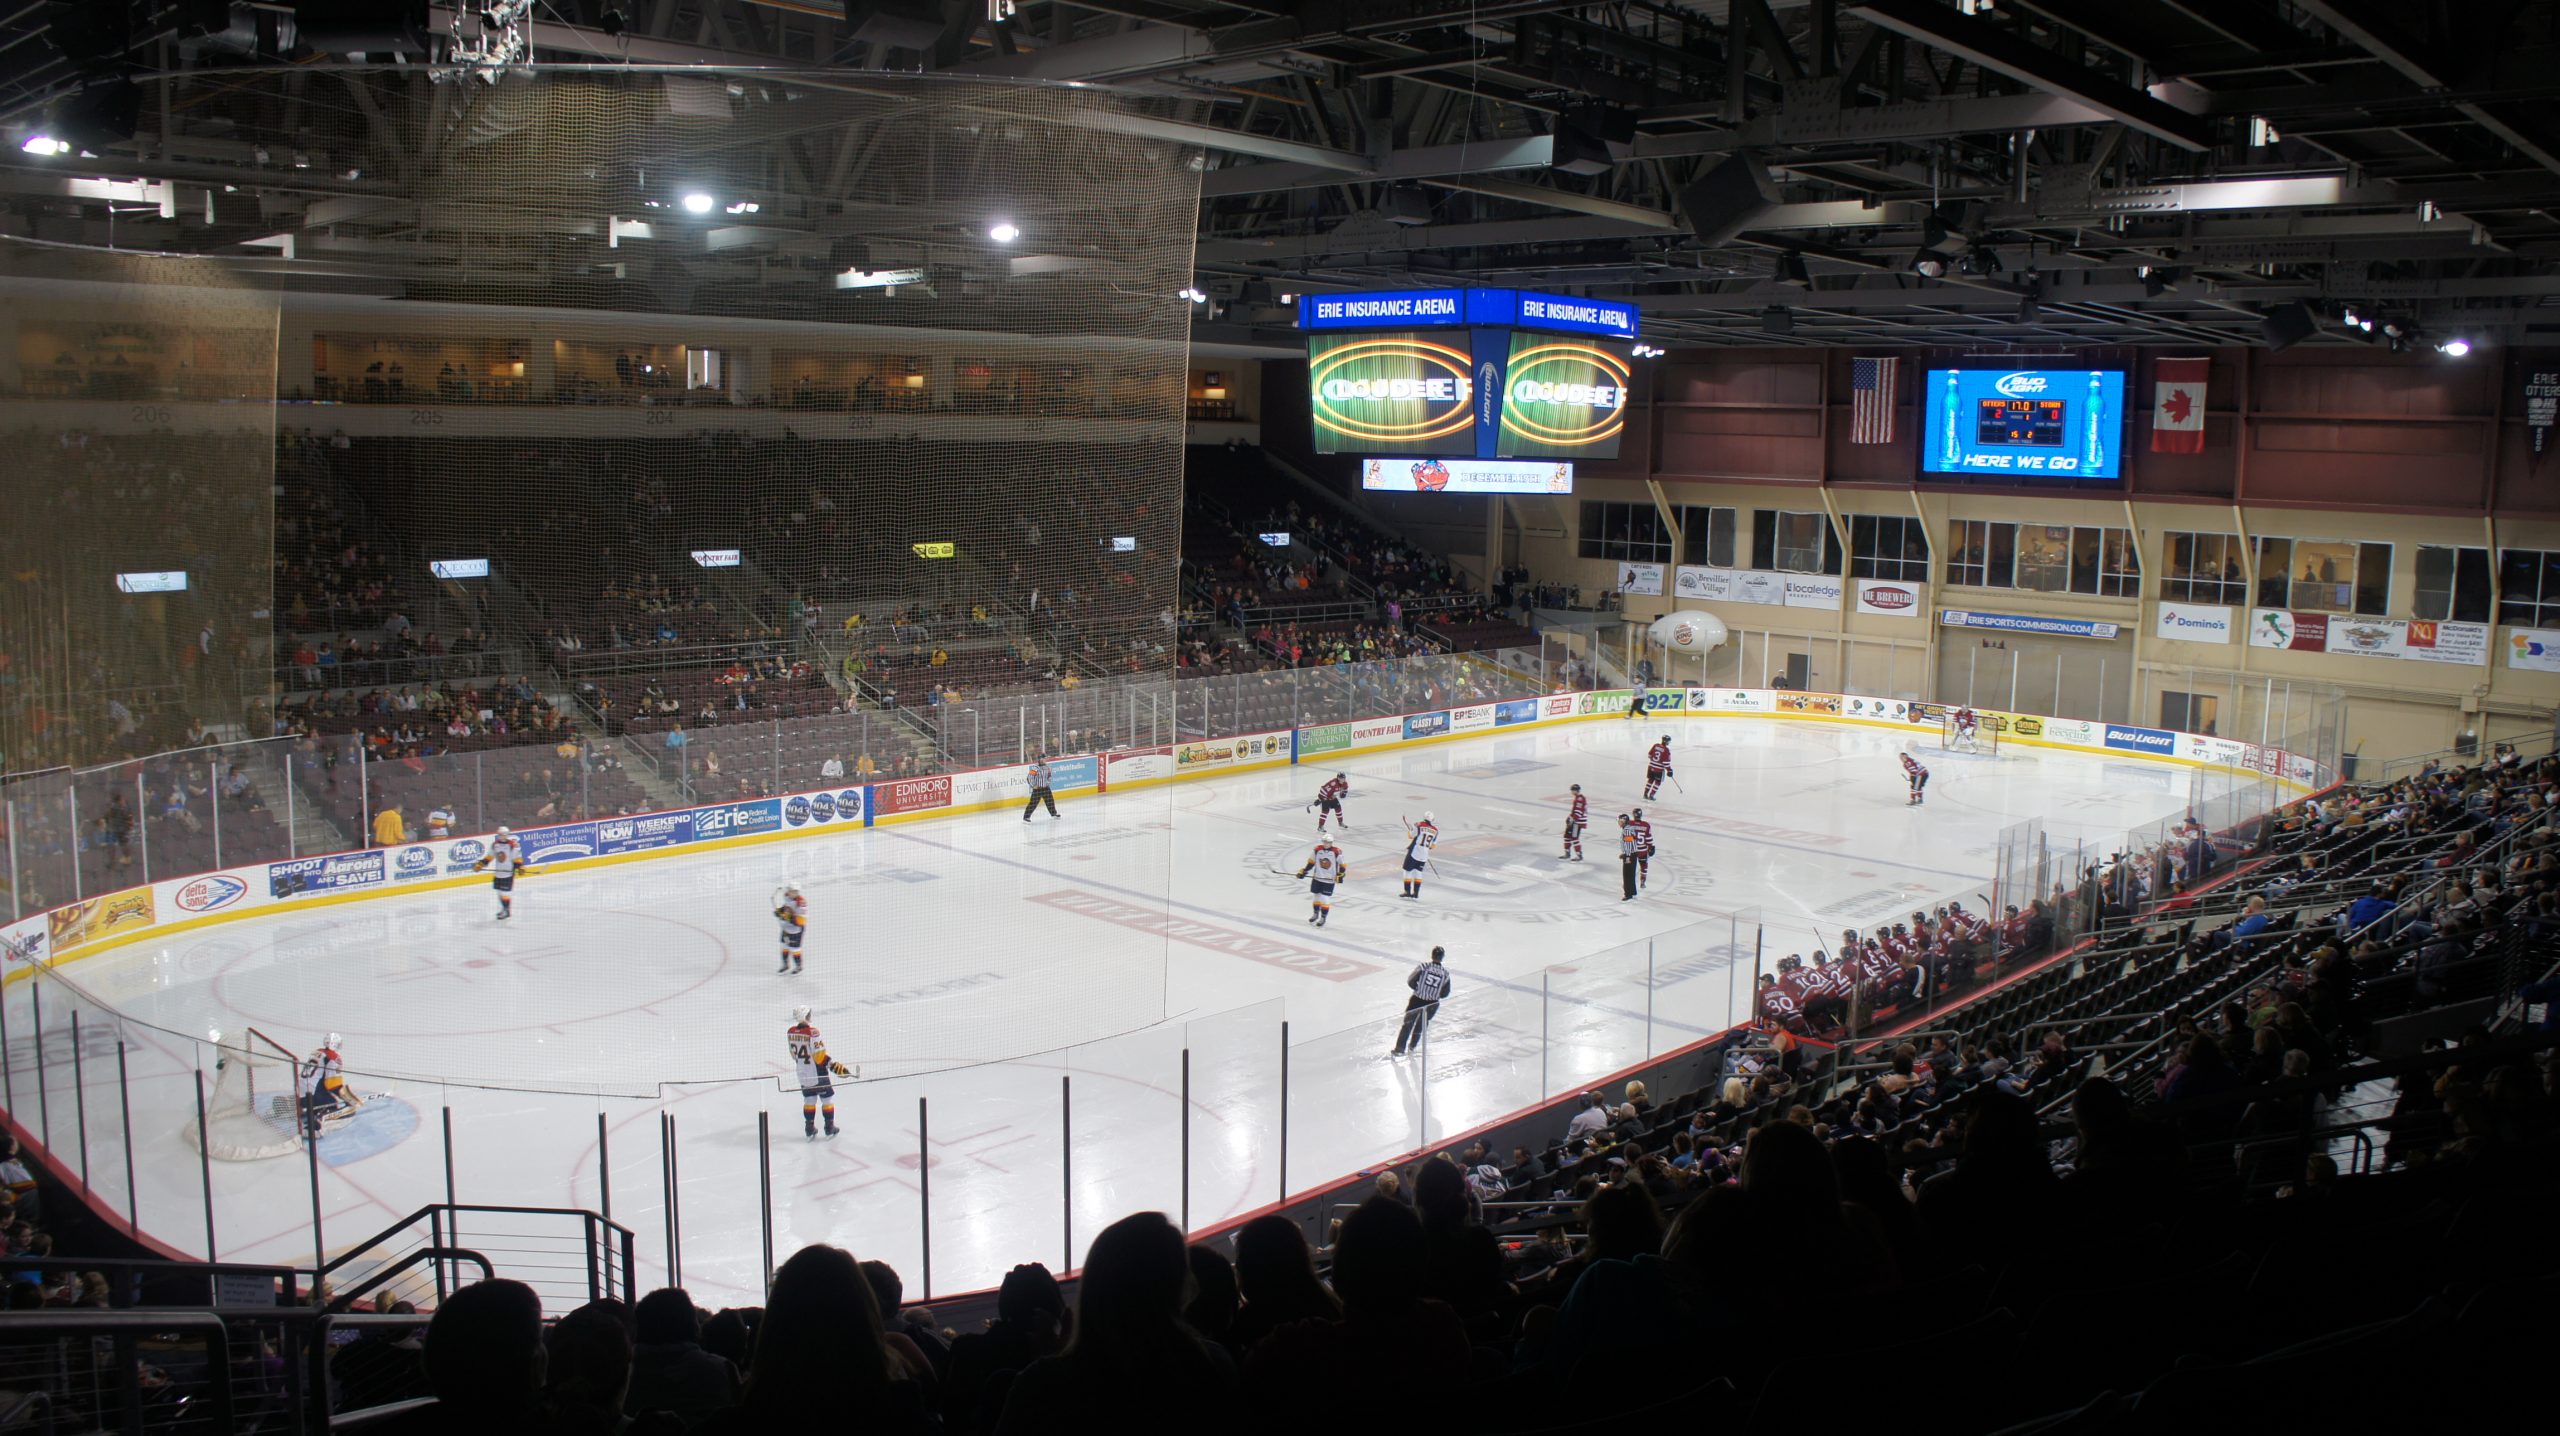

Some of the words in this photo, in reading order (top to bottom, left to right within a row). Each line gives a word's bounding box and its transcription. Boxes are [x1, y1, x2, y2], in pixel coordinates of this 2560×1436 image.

[1318, 303, 1342, 318] ERIE
[1345, 300, 1411, 317] INSURANCE
[1414, 298, 1456, 315] ARENA
[1523, 300, 1545, 317] ERIE
[1546, 303, 1597, 322] INSURANCE
[1598, 309, 1628, 328] ARENA
[2010, 376, 2046, 385] BUD
[2533, 373, 2558, 384] ERIE
[2003, 384, 2048, 392] LIGHT
[2012, 401, 2030, 411] 17.0
[132, 406, 170, 423] 206
[412, 410, 443, 424] 205
[646, 411, 673, 424] 204
[1995, 409, 2002, 418] 2
[2051, 410, 2058, 419] 0
[2027, 431, 2033, 439] 2
[1963, 454, 2013, 468] HERE
[2017, 456, 2046, 469] WE
[2048, 456, 2078, 470] GO
[1698, 573, 1729, 583] Brevillier
[1702, 583, 1727, 594] Village
[1793, 583, 1841, 597] localedge
[1968, 615, 1984, 625] ERIE
[1985, 617, 2015, 628] SPORTS
[2015, 620, 2091, 634] COMMISSION.COM
[2177, 617, 2226, 630] Domino's
[2442, 625, 2482, 633] McDonald's
[1676, 631, 1692, 640] KING
[1647, 694, 1684, 710] 92.7
[1310, 724, 1350, 737] MERCYHURST
[1411, 718, 1431, 729] CLASSY
[1310, 733, 1349, 745] UNIVERSITY
[1353, 727, 1386, 740] COUNTRY
[1386, 724, 1402, 735] FAIR
[2107, 730, 2134, 741] BUD
[2135, 734, 2174, 747] LIGHT
[1652, 751, 1661, 762] 3
[896, 778, 949, 797] EDINBORO
[956, 784, 982, 794] UPMC
[983, 780, 1010, 791] HEALTH
[1010, 777, 1028, 788] PLAN
[896, 790, 948, 805] UNIVERSITY
[615, 819, 634, 828] NEWS
[636, 814, 691, 829] WEEKEND
[714, 807, 749, 829] Erie
[749, 807, 767, 816] Federal
[749, 815, 765, 824] Credit
[765, 813, 780, 822] Union
[523, 829, 559, 841] Millcreek
[560, 826, 596, 837] Township
[600, 826, 633, 841] NOW
[1420, 833, 1433, 848] 19
[1636, 831, 1645, 845] 5
[532, 838, 557, 848] School
[559, 834, 587, 844] District
[403, 850, 426, 863] FOX
[455, 843, 477, 856] FOX
[271, 859, 323, 877] SHOOT
[304, 869, 322, 877] INTO
[324, 856, 382, 877] Aaron's
[336, 870, 382, 886] SAVE!
[185, 883, 208, 898] delta
[186, 896, 208, 908] sonic
[1249, 873, 1491, 924] INSURNCE
[1515, 906, 1630, 925] ERIE
[1139, 916, 1359, 974] COUNTRY
[1425, 974, 1441, 987] 57
[1767, 996, 1793, 1015] 30
[813, 1041, 824, 1050] 24
